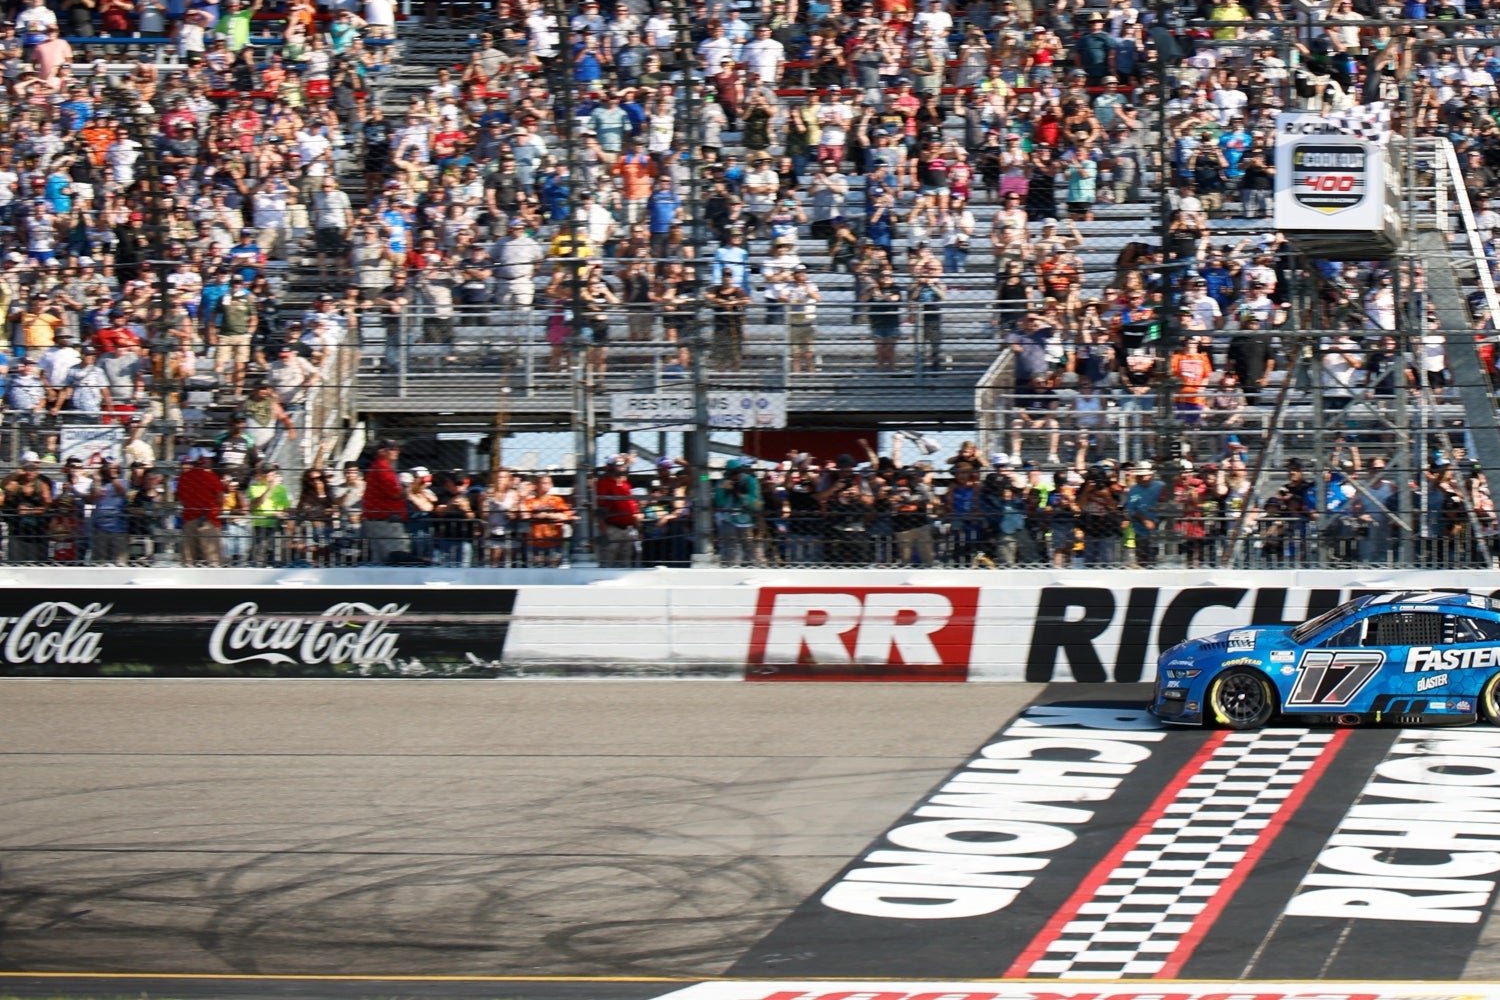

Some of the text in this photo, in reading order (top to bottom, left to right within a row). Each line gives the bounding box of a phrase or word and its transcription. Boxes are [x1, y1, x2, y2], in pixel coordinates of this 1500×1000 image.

[1304, 175, 1356, 192] 400
[209, 602, 411, 665] Coca-Cola
[763, 592, 954, 665] RR
[1284, 648, 1387, 707] 17
